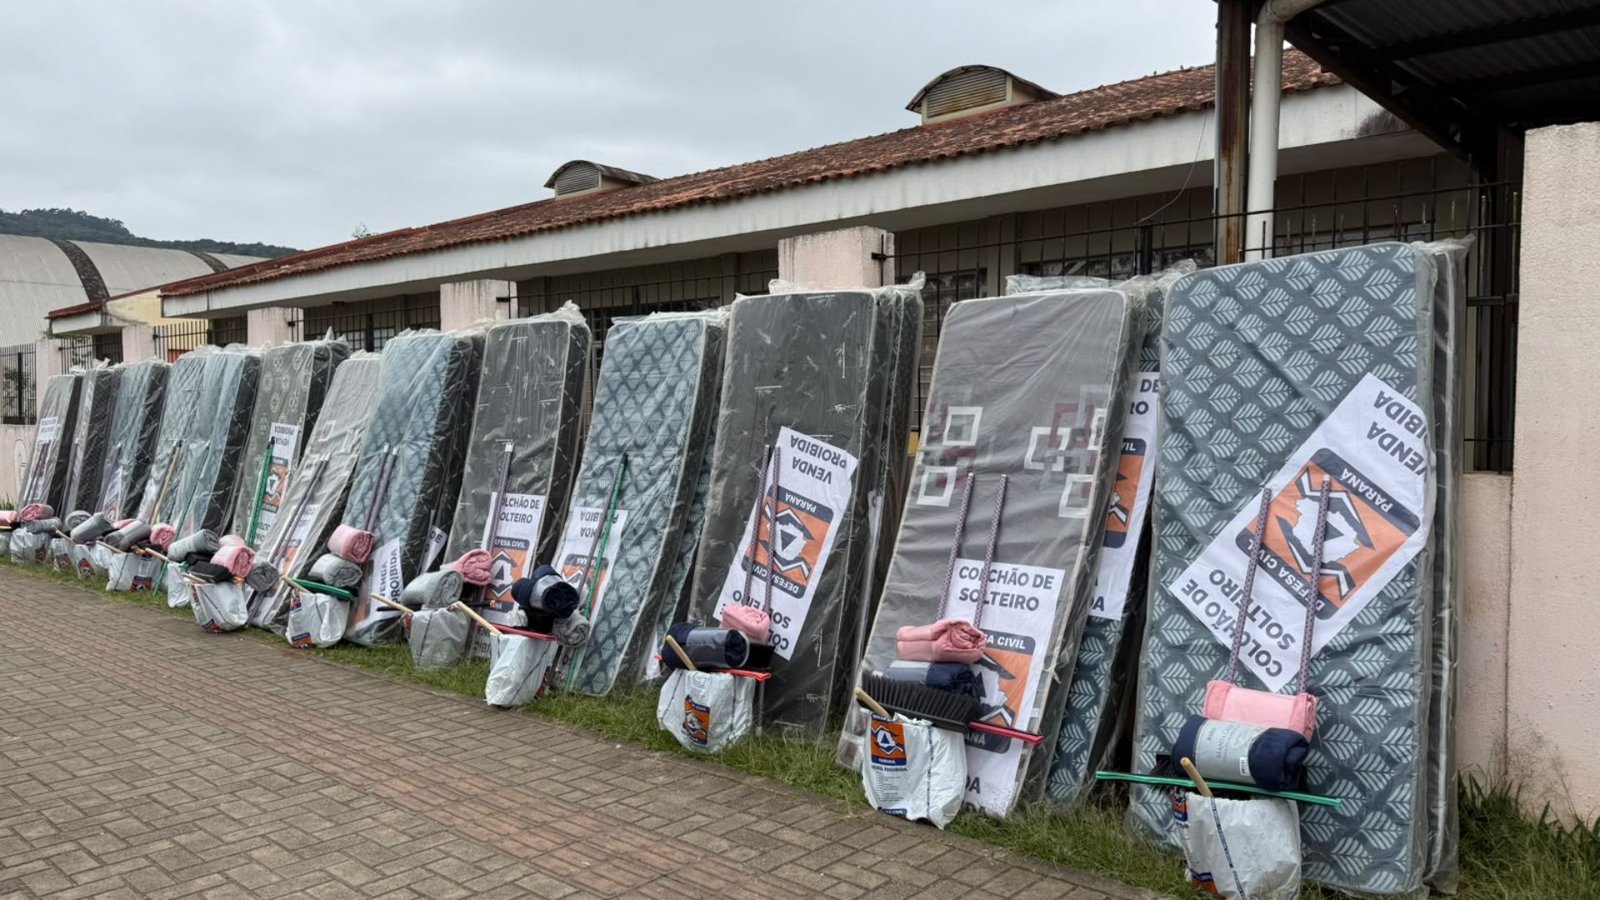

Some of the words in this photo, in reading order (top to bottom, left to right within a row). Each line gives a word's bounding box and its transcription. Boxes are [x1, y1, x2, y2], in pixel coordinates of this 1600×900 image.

[1374, 390, 1428, 440] IBIDA
[790, 434, 847, 469] PROIBIDA
[792, 456, 833, 484] VENDA
[530, 499, 541, 509] DE
[1341, 467, 1393, 513] PARANÁ
[500, 512, 533, 524] OLTEIRO
[1246, 538, 1279, 570] CIVL
[774, 573, 799, 594] DEFES
[1033, 573, 1056, 590] DE
[1181, 579, 1213, 607] DE
[1278, 565, 1326, 612] DFESA
[997, 636, 1027, 651] CIVIL
